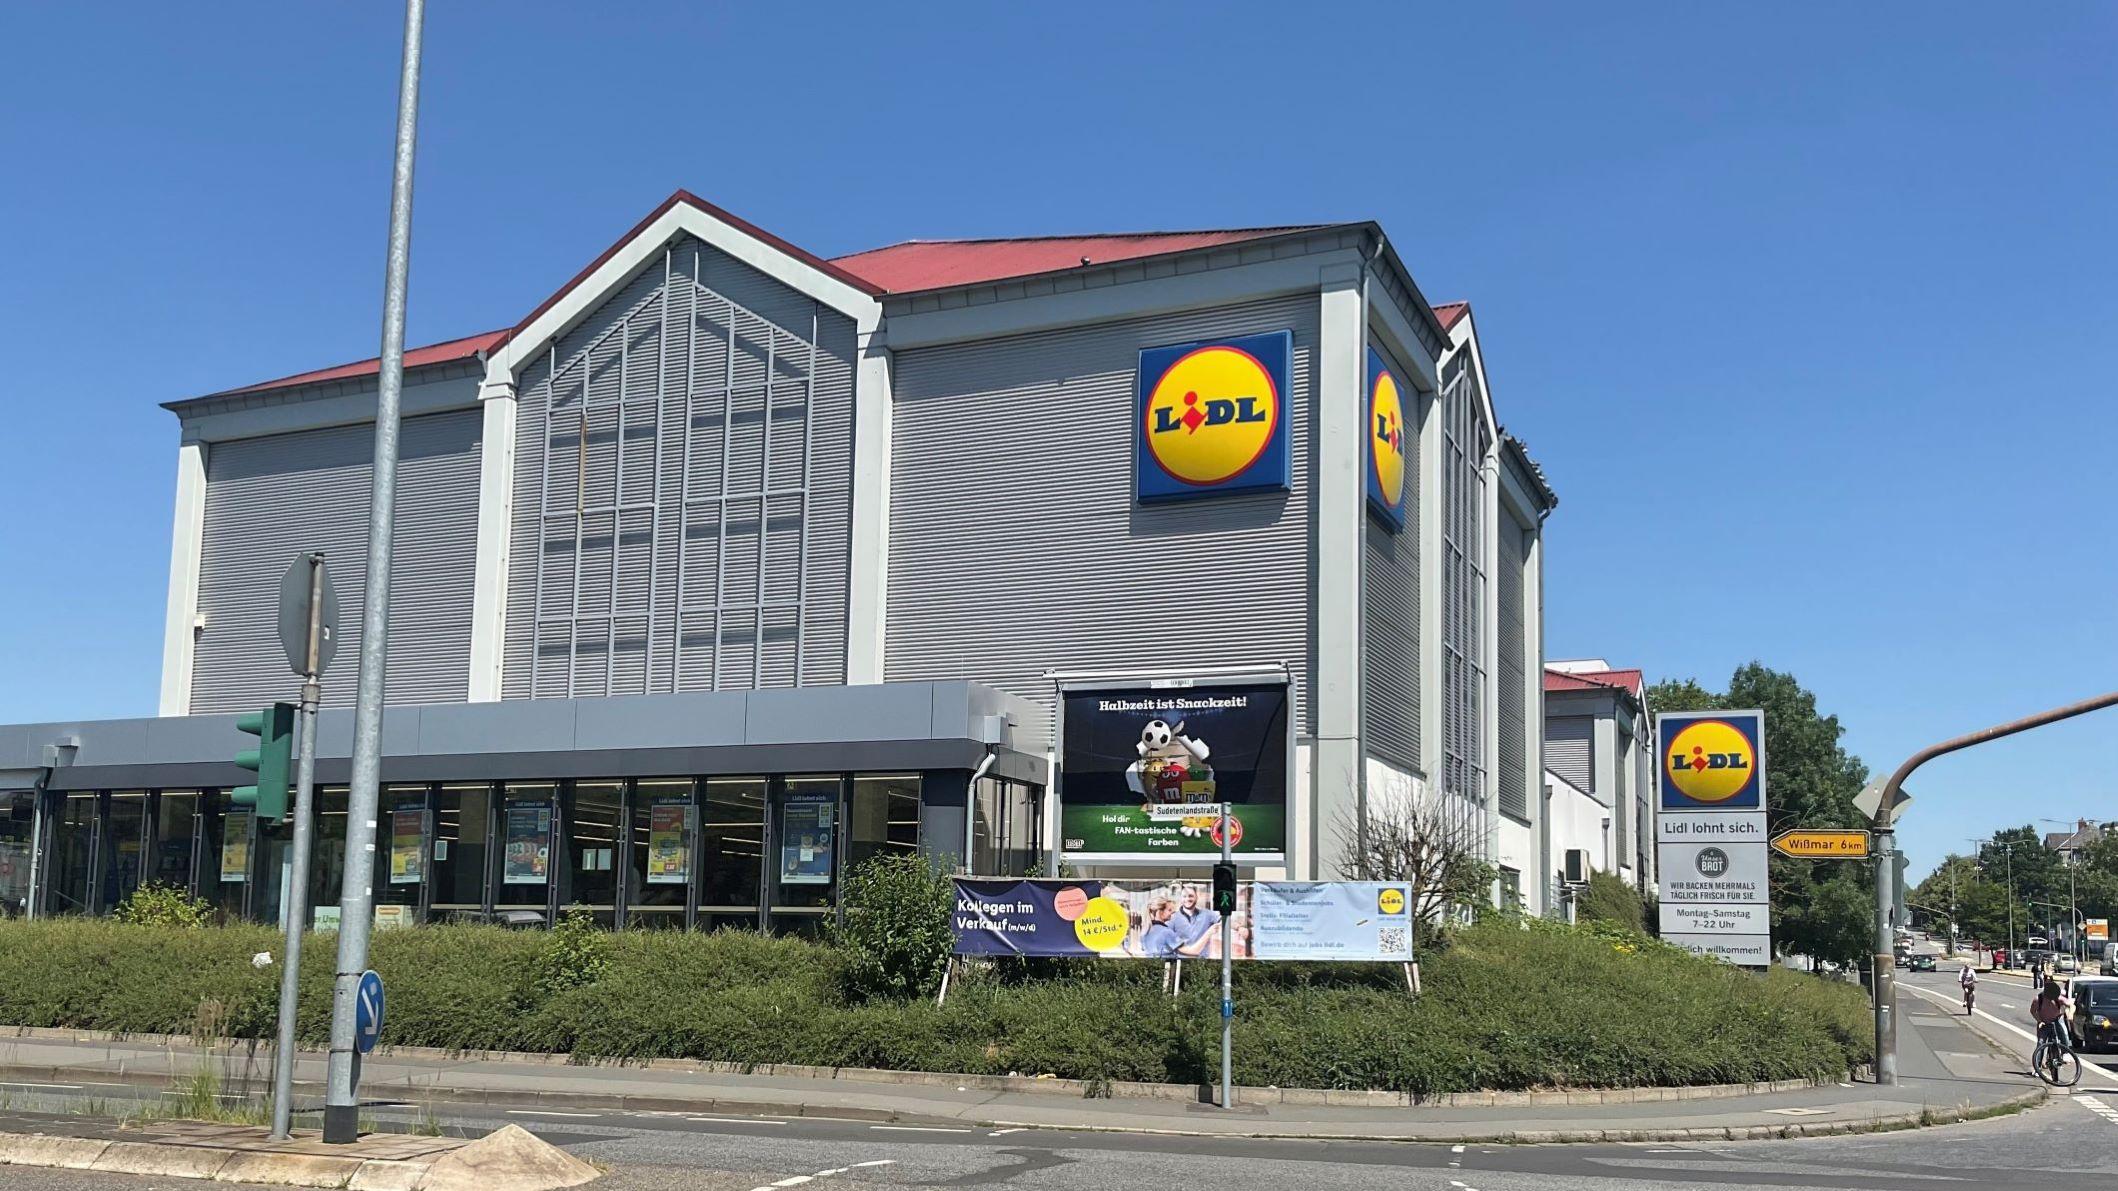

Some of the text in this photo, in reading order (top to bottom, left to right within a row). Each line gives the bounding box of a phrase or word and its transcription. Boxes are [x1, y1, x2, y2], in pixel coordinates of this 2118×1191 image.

[1099, 696, 1248, 711] Halbzeit ist Snackzeit!
[1157, 806, 1219, 815] Sudetenlandstraße
[1102, 815, 1131, 823] Hol dir
[1115, 826, 1177, 835] FAN-tastische
[1665, 821, 1759, 833] Lidl lohnt sich.
[1148, 838, 1179, 846] Farben
[1788, 839, 1862, 850] Wißmar 6 km
[1701, 861, 1724, 871] BROT
[1670, 882, 1756, 890] WIR BACKEN MEHRMALS
[1670, 891, 1697, 900] TÄGLICH
[1700, 891, 1725, 900] FRISCH
[1727, 891, 1740, 900] FÜR
[958, 899, 1034, 916] Kollegen im
[957, 916, 1036, 932] Verkauf (m/w/d)
[1081, 916, 1104, 925] Mind.
[1719, 920, 1736, 929] Uhr
[1083, 928, 1091, 936] 14
[1706, 945, 1762, 955] willkommen!
